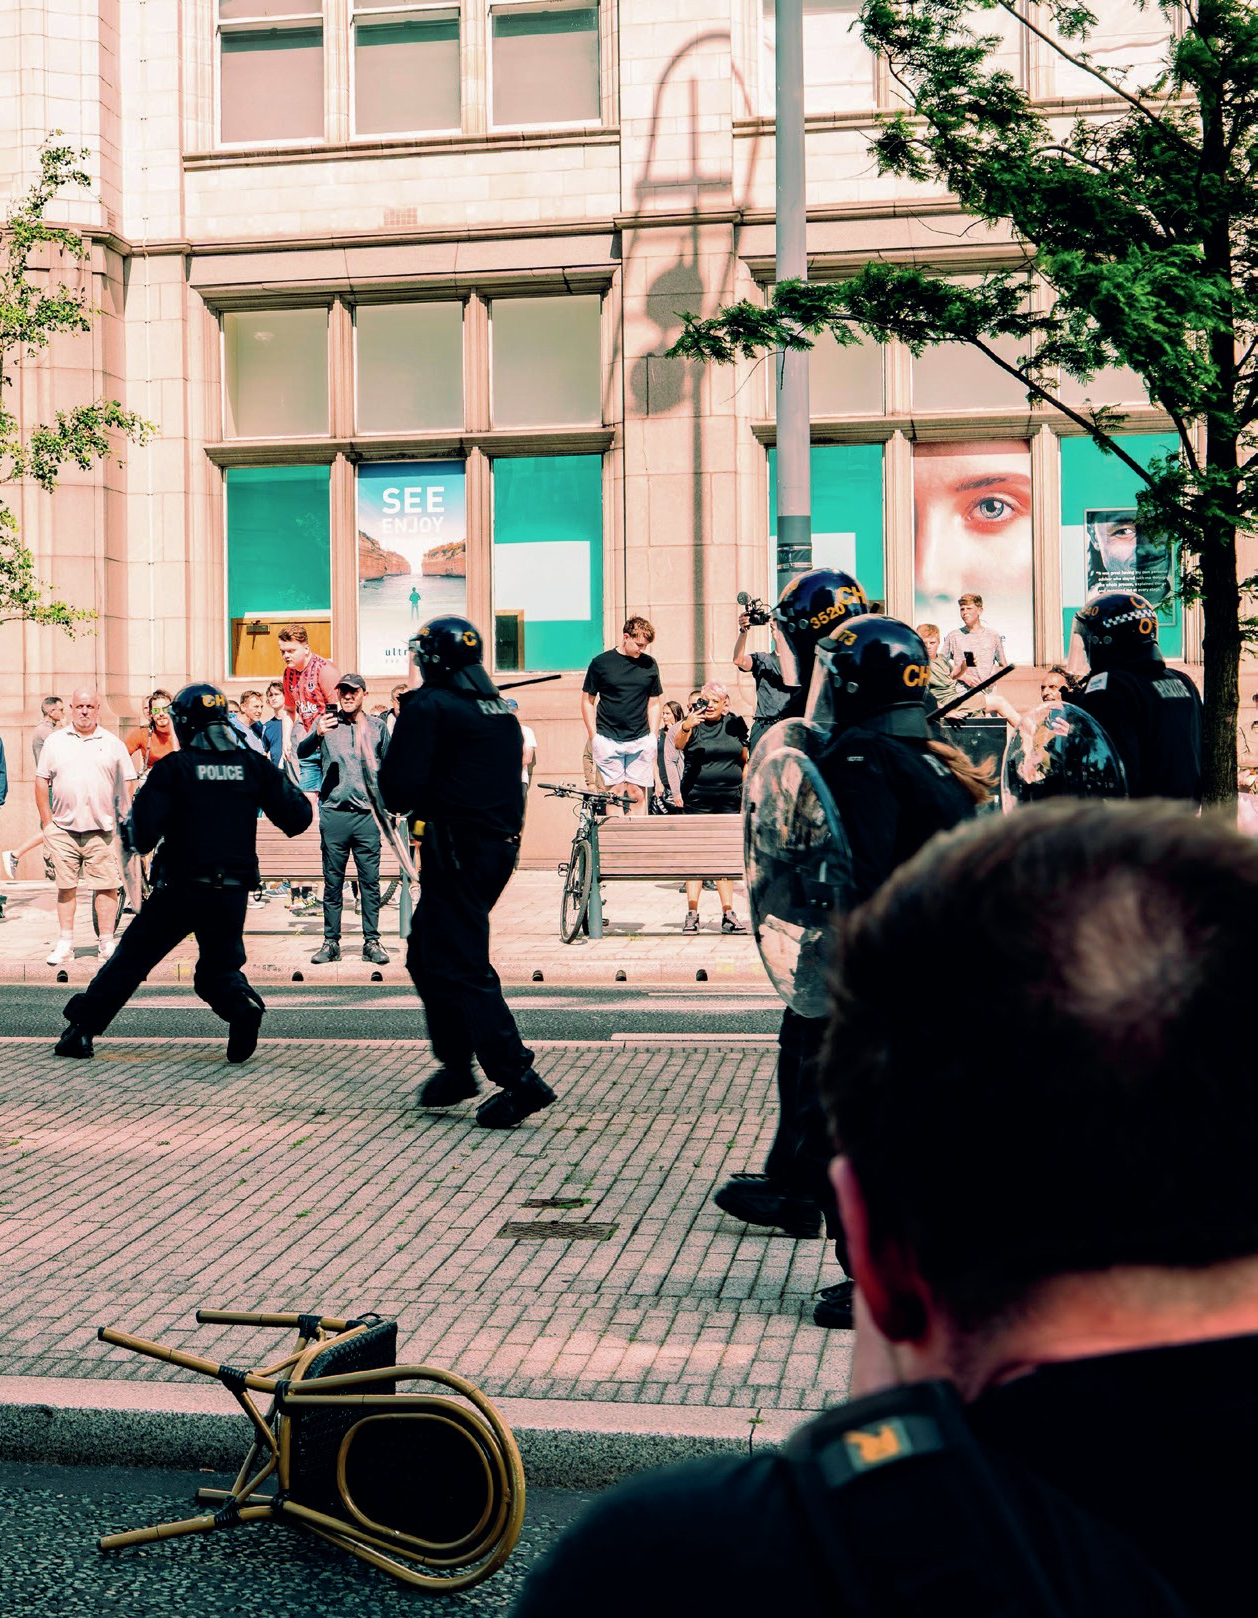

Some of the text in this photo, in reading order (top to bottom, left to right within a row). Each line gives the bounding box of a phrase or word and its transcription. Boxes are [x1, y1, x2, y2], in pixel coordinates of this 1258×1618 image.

[382, 486, 445, 514] SEE
[382, 516, 444, 534] ENJOY
[837, 586, 867, 605] CH
[809, 603, 846, 630] 3520
[902, 664, 931, 688] CH
[202, 694, 226, 708] CH
[197, 765, 244, 780] POLICE
